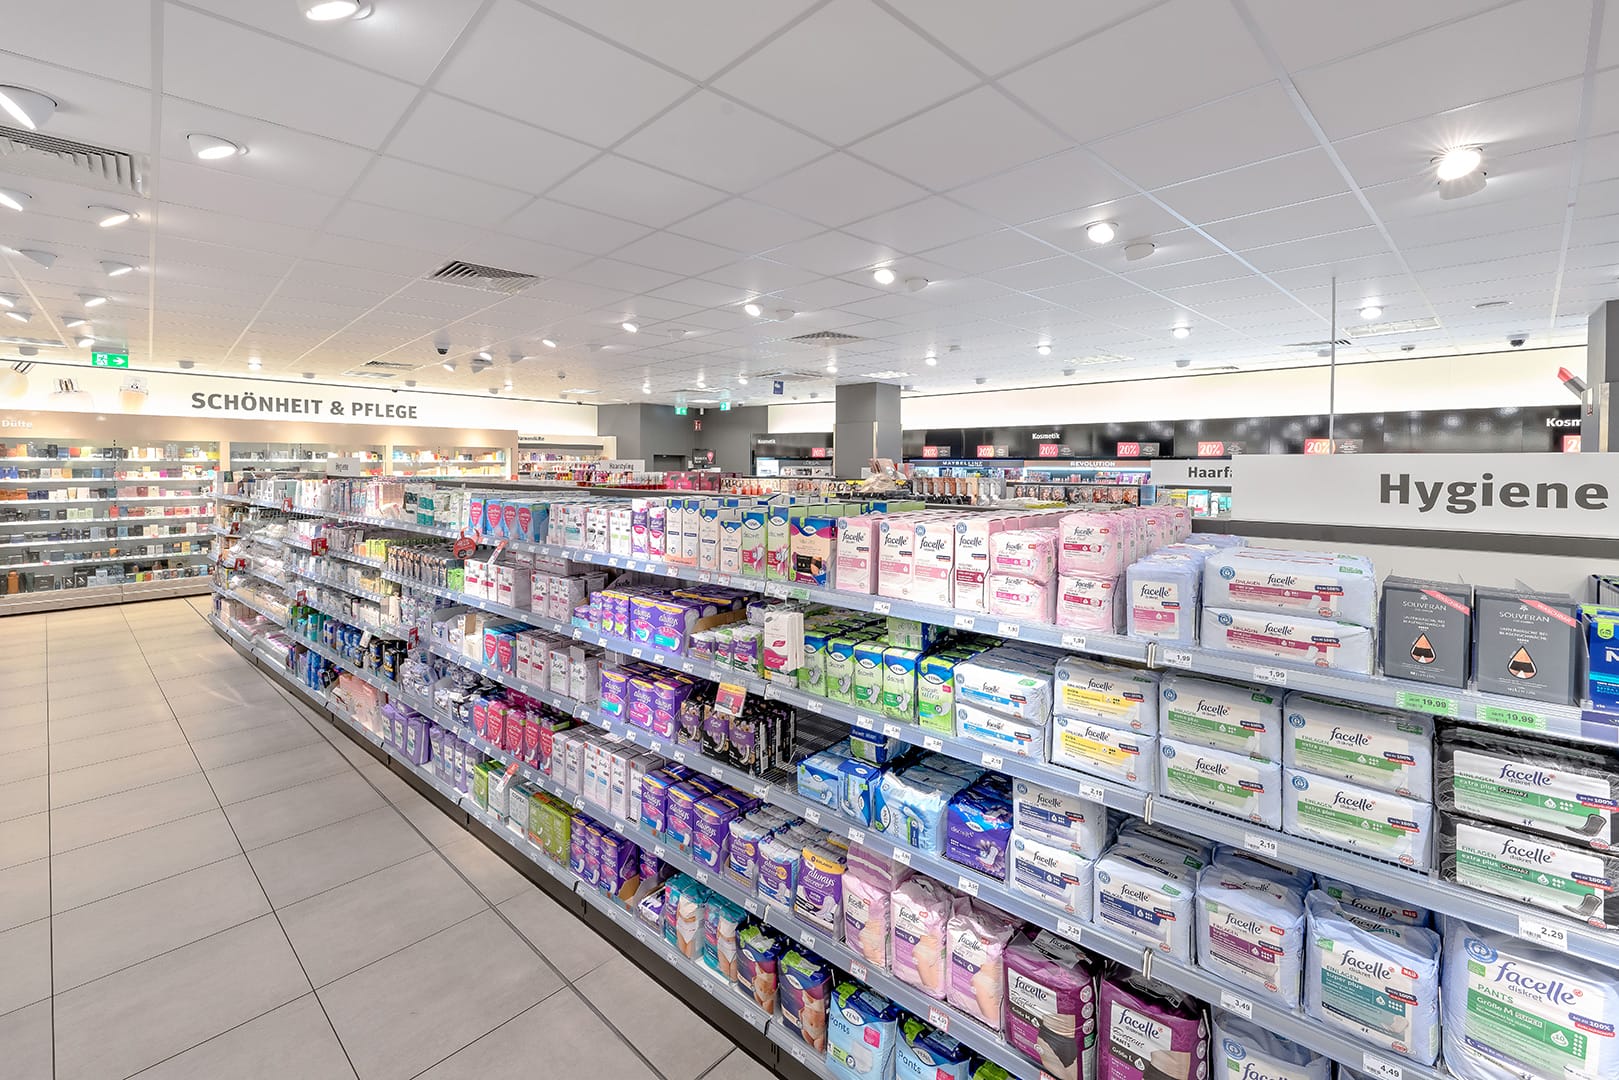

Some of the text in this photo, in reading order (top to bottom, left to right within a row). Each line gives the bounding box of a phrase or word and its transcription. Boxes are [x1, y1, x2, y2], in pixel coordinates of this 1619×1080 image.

[191, 391, 418, 419] SCHÖNHEIT & PFLEGE
[1032, 432, 1060, 440] Kosmetik
[979, 446, 994, 456] 20%
[1040, 445, 1056, 455] 20%
[1119, 444, 1137, 455] 20%
[1200, 444, 1220, 455] 20%
[1380, 472, 1609, 514] Hygiene
[842, 530, 865, 542] facelle
[884, 531, 908, 546] facelle
[920, 536, 945, 550] facelle
[960, 534, 982, 548] facelle
[1266, 574, 1296, 586] facelle
[1140, 584, 1171, 598] facelle
[1402, 600, 1447, 611] SOUVERAN
[1499, 611, 1550, 623] SOUVERAN
[1264, 622, 1292, 636] facelle
[1087, 678, 1114, 692] facelle
[1196, 700, 1229, 716] facelle
[1422, 699, 1447, 709] 19.99
[1506, 713, 1534, 724] 19.99
[1084, 726, 1110, 741] facelle
[1330, 726, 1369, 747] facelle
[1196, 758, 1227, 776] facelle
[1500, 764, 1553, 787] facelle
[1459, 779, 1529, 799] extra plus SCHWARZ
[1036, 793, 1062, 808] facelle
[1333, 790, 1374, 812] facelle
[1260, 840, 1276, 850] 2.19
[1462, 845, 1497, 859] EINLAGEN
[1500, 839, 1553, 864] facelle
[1033, 850, 1058, 868] facelle
[1462, 853, 1530, 875] extra plus SCHWARZ
[808, 866, 836, 887] always
[1120, 884, 1150, 902] facelle
[1225, 912, 1262, 935] facelle
[1541, 926, 1564, 940] 2.29
[1340, 950, 1392, 980] facelle
[1326, 965, 1360, 982] EINLAGEN
[1014, 975, 1048, 1002] facelle
[1326, 972, 1346, 985] super
[1348, 980, 1363, 991] plus
[1494, 961, 1577, 1006] facelle
[1477, 983, 1514, 1004] PANTS
[1508, 983, 1543, 1004] diskret
[1234, 1000, 1250, 1011] 3.49
[1504, 1006, 1514, 1016] M
[1119, 1008, 1160, 1039] facelle
[1589, 1020, 1611, 1031] 100%
[1380, 1064, 1400, 1078] 4.49
